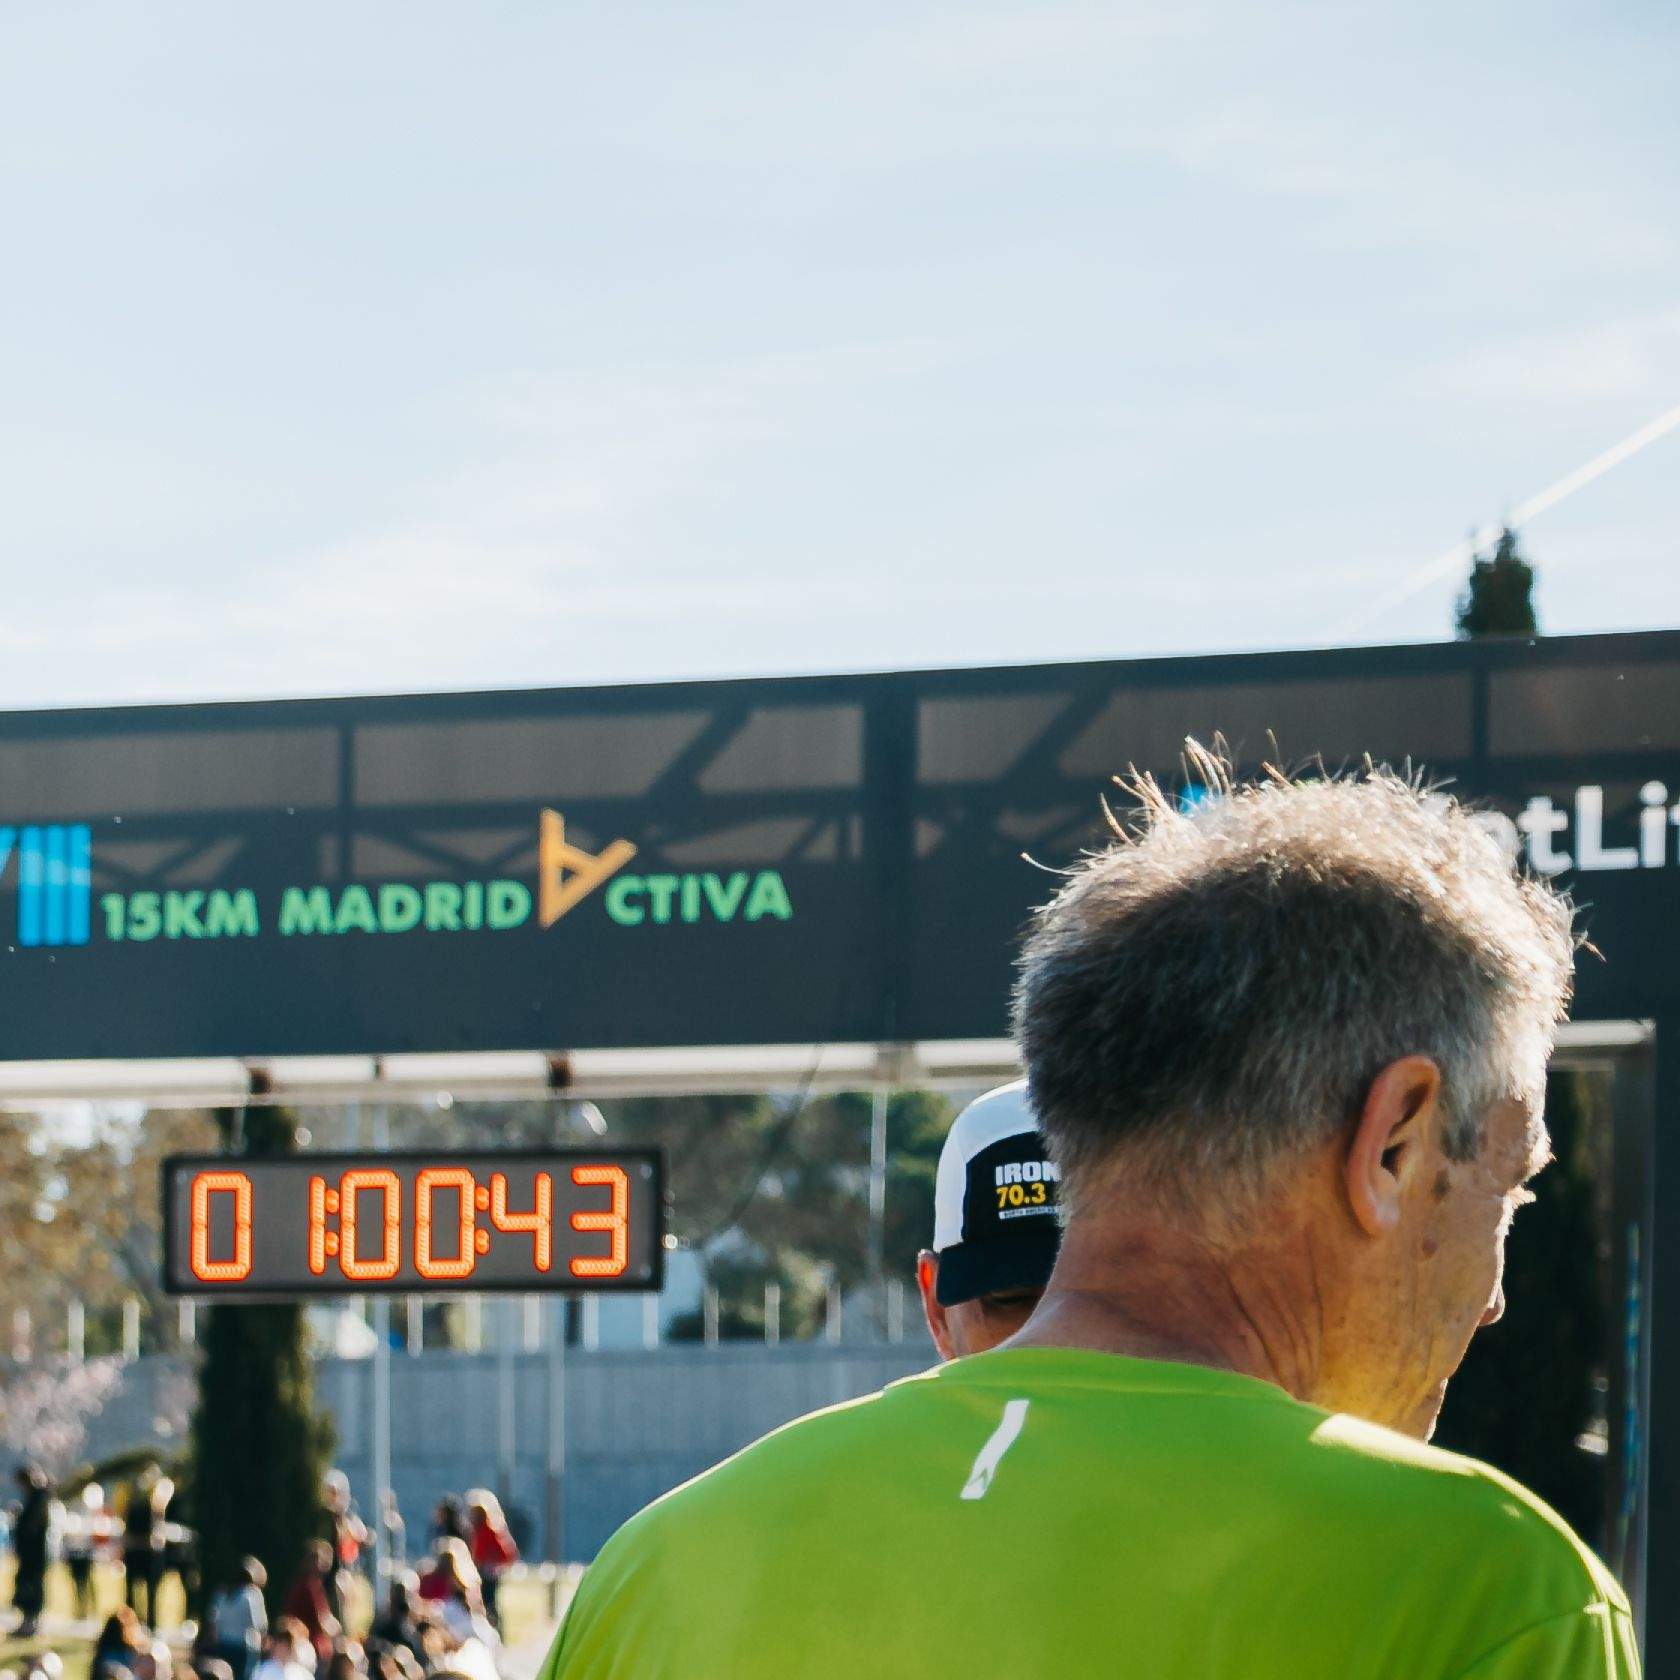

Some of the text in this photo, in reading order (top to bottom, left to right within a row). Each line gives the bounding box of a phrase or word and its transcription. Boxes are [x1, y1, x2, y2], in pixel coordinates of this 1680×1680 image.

[100, 888, 259, 942] 15KM
[279, 880, 532, 936] MADRID
[995, 1161, 1061, 1187] IRON
[996, 1182, 1046, 1208] 70.3
[191, 1171, 252, 1282] 0
